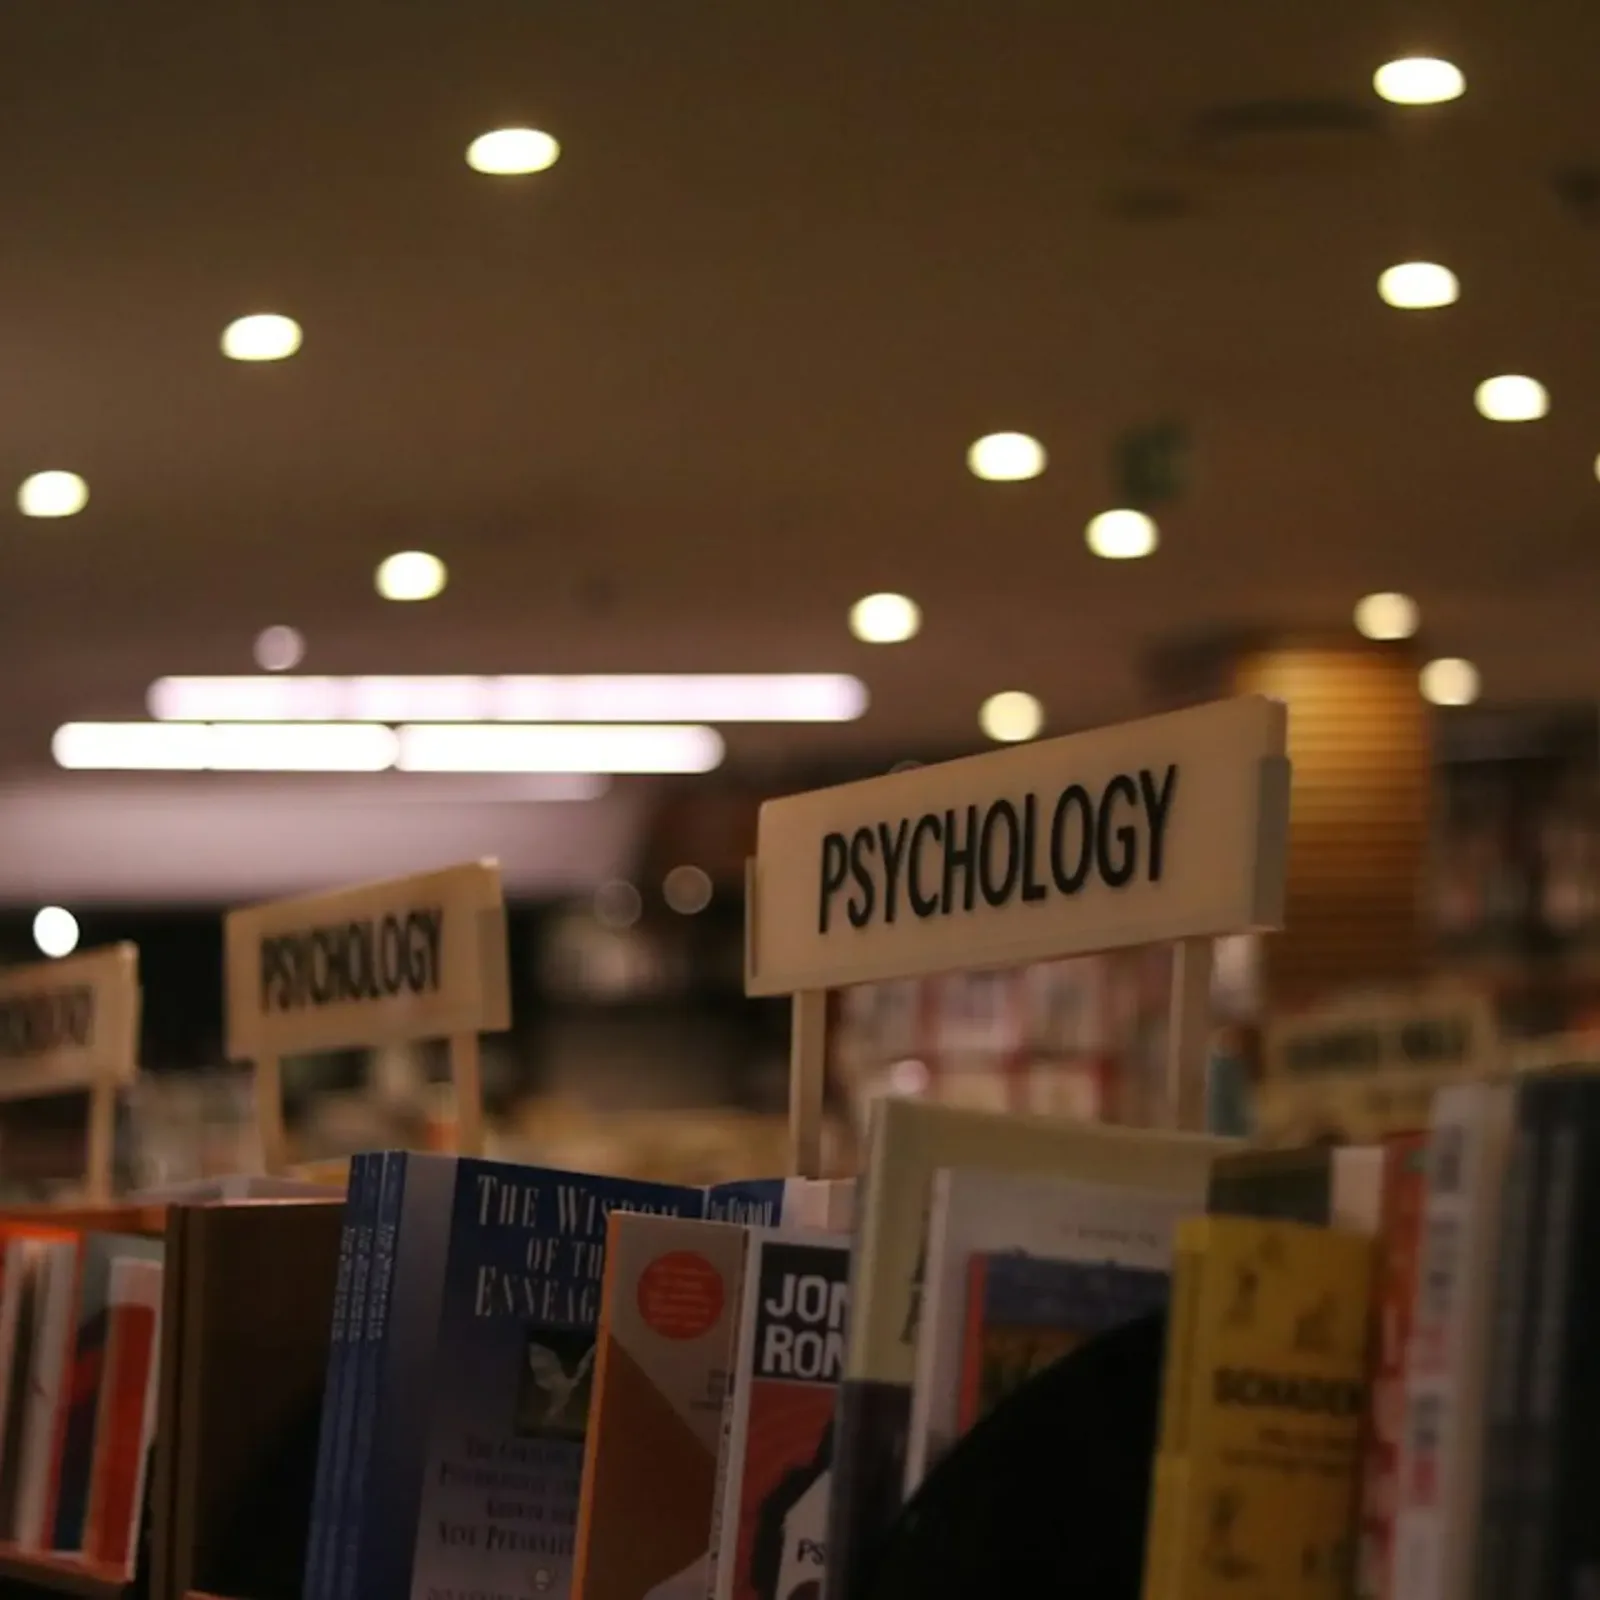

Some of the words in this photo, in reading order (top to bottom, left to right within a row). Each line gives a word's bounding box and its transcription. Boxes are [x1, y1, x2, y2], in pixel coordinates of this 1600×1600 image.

[819, 764, 1177, 933] PSYCHOLOGY
[260, 908, 441, 1016] PSYCHOLOGY
[477, 1174, 540, 1229] THE
[526, 1236, 560, 1274] OF
[573, 1240, 603, 1280] TH
